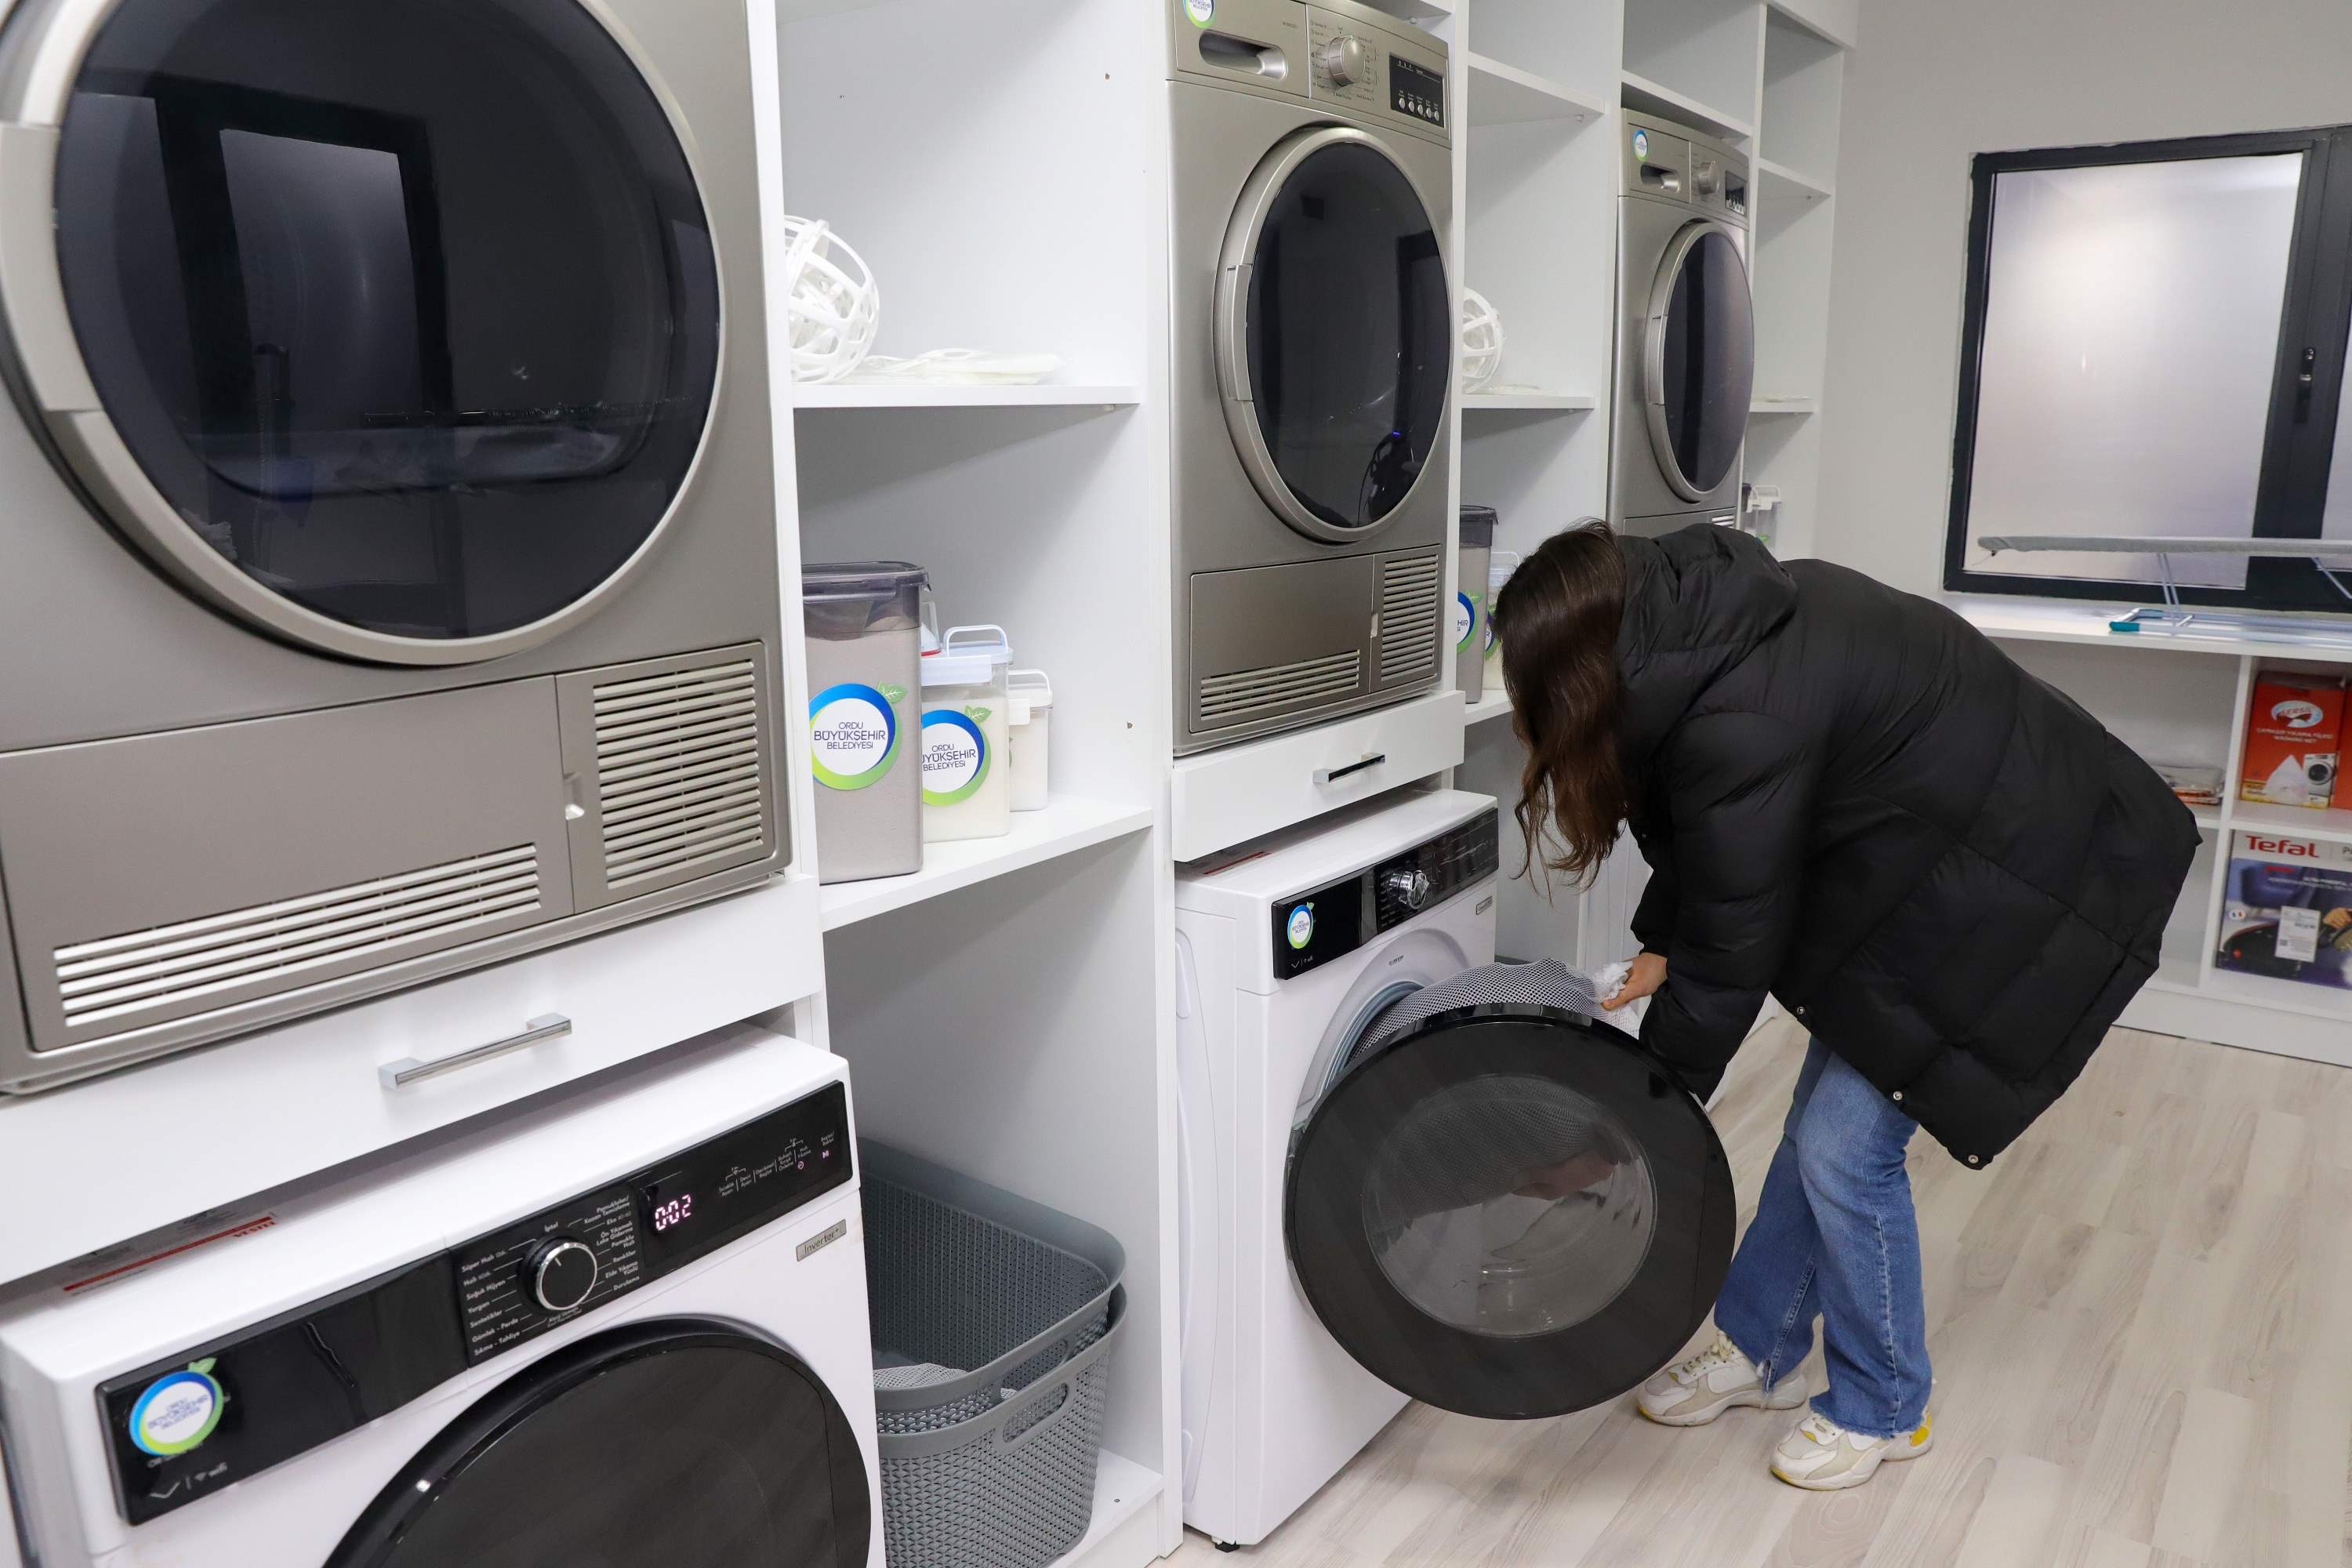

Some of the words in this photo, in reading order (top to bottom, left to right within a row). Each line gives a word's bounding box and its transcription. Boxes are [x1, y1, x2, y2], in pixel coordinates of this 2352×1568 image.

[838, 721, 864, 730] ORDU
[814, 730, 886, 741] BÜYÜKŞEHİR
[931, 743, 955, 752] ORDU
[2245, 835, 2319, 858] Tefal
